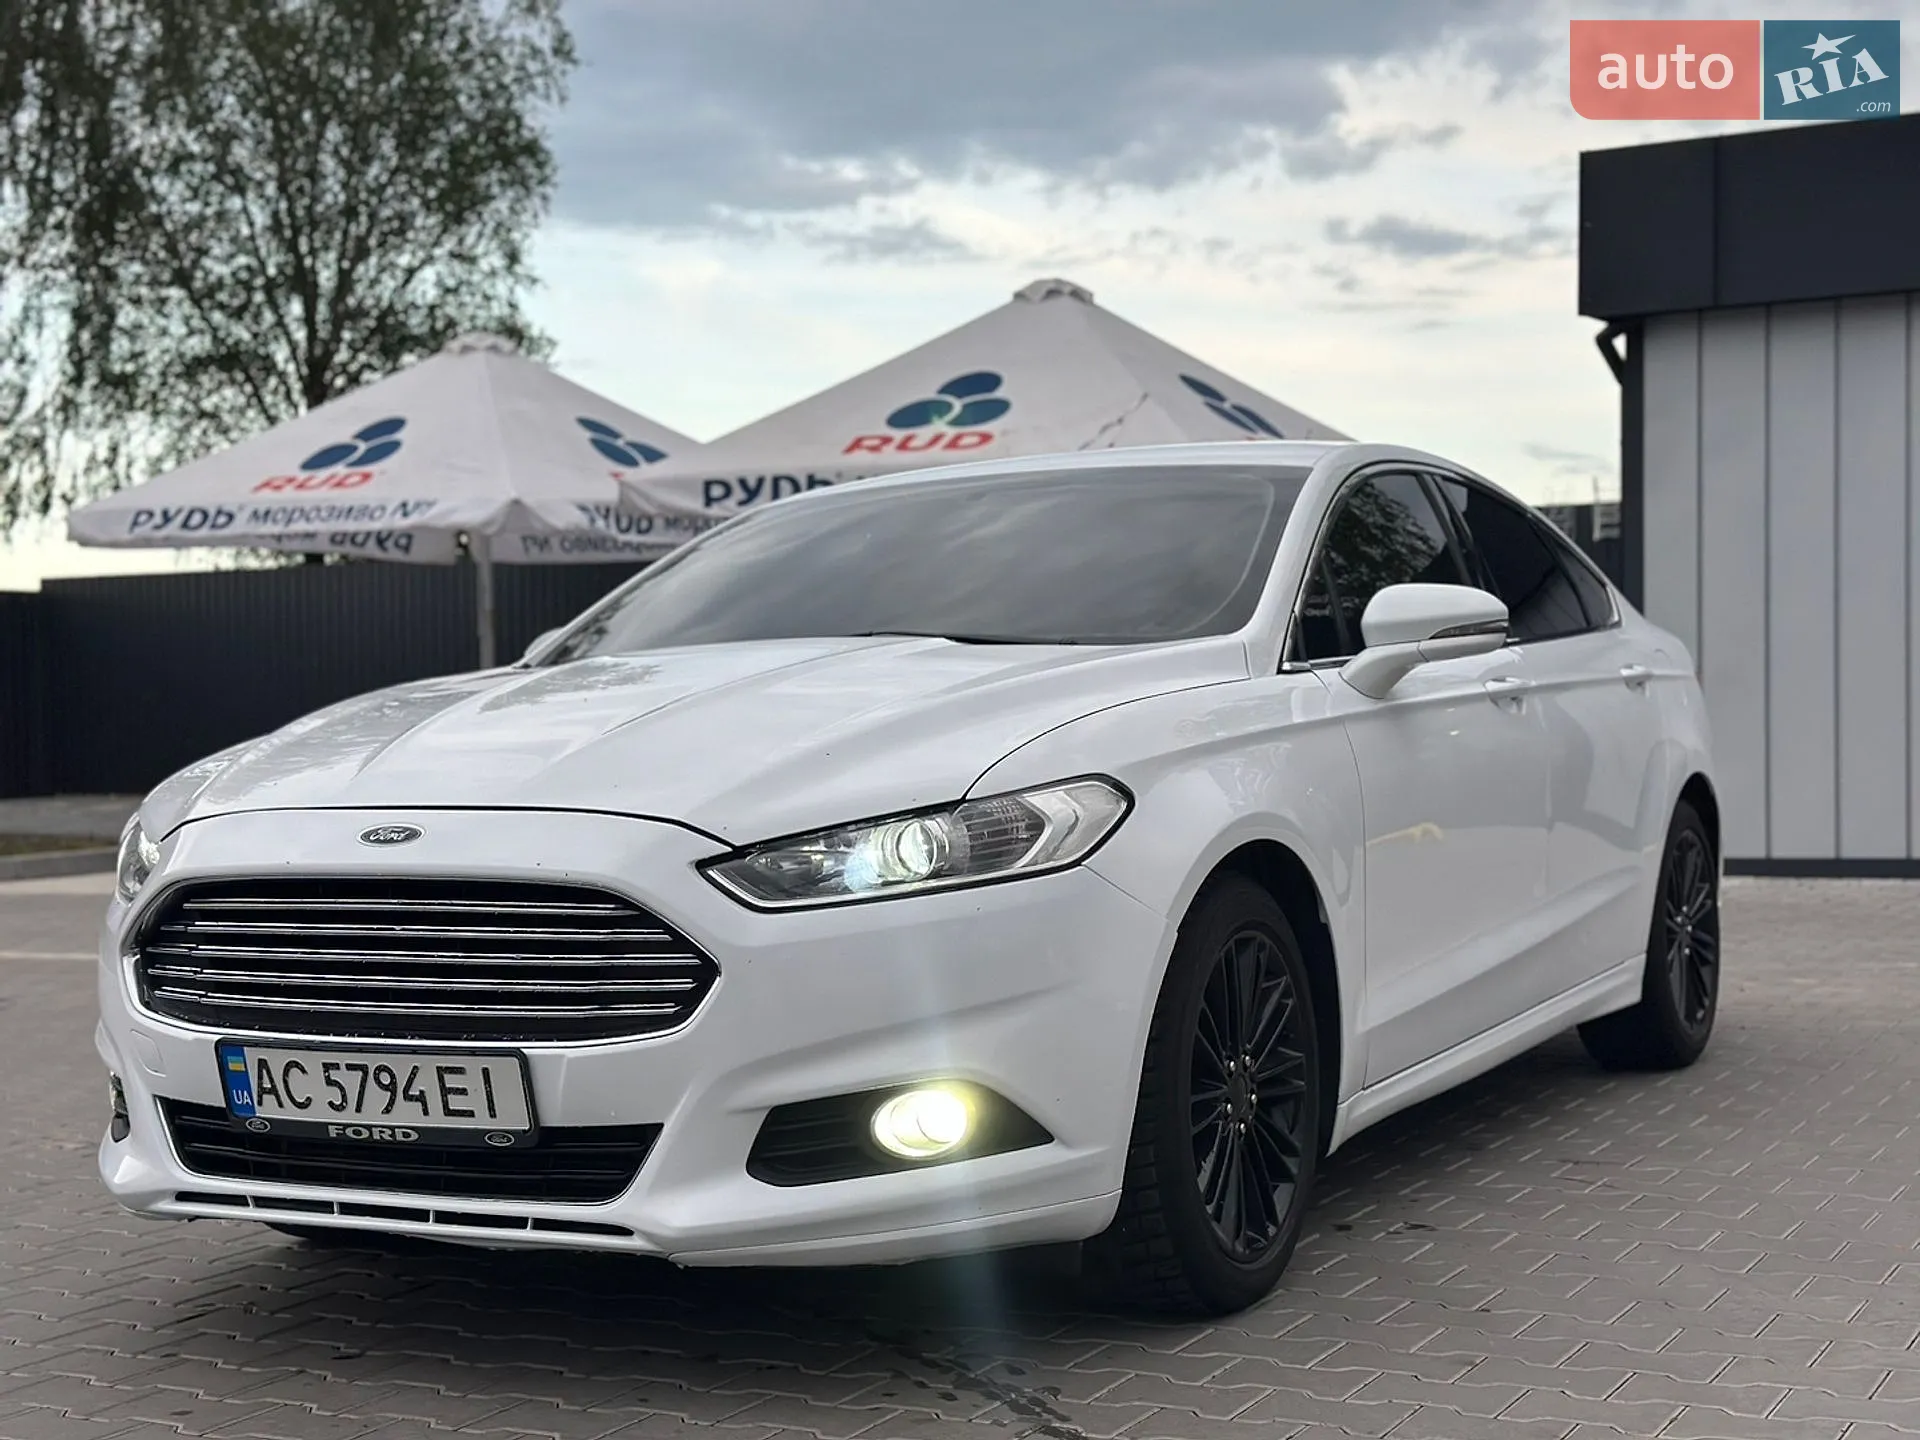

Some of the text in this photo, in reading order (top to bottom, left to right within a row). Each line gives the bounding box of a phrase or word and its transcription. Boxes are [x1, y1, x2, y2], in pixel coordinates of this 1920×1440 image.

[841, 431, 995, 456] RUD
[252, 471, 375, 494] RUD
[128, 506, 235, 534] РУДЬ
[246, 503, 387, 528] морозиво
[232, 1088, 253, 1106] UA
[327, 1124, 420, 1143] FORD
